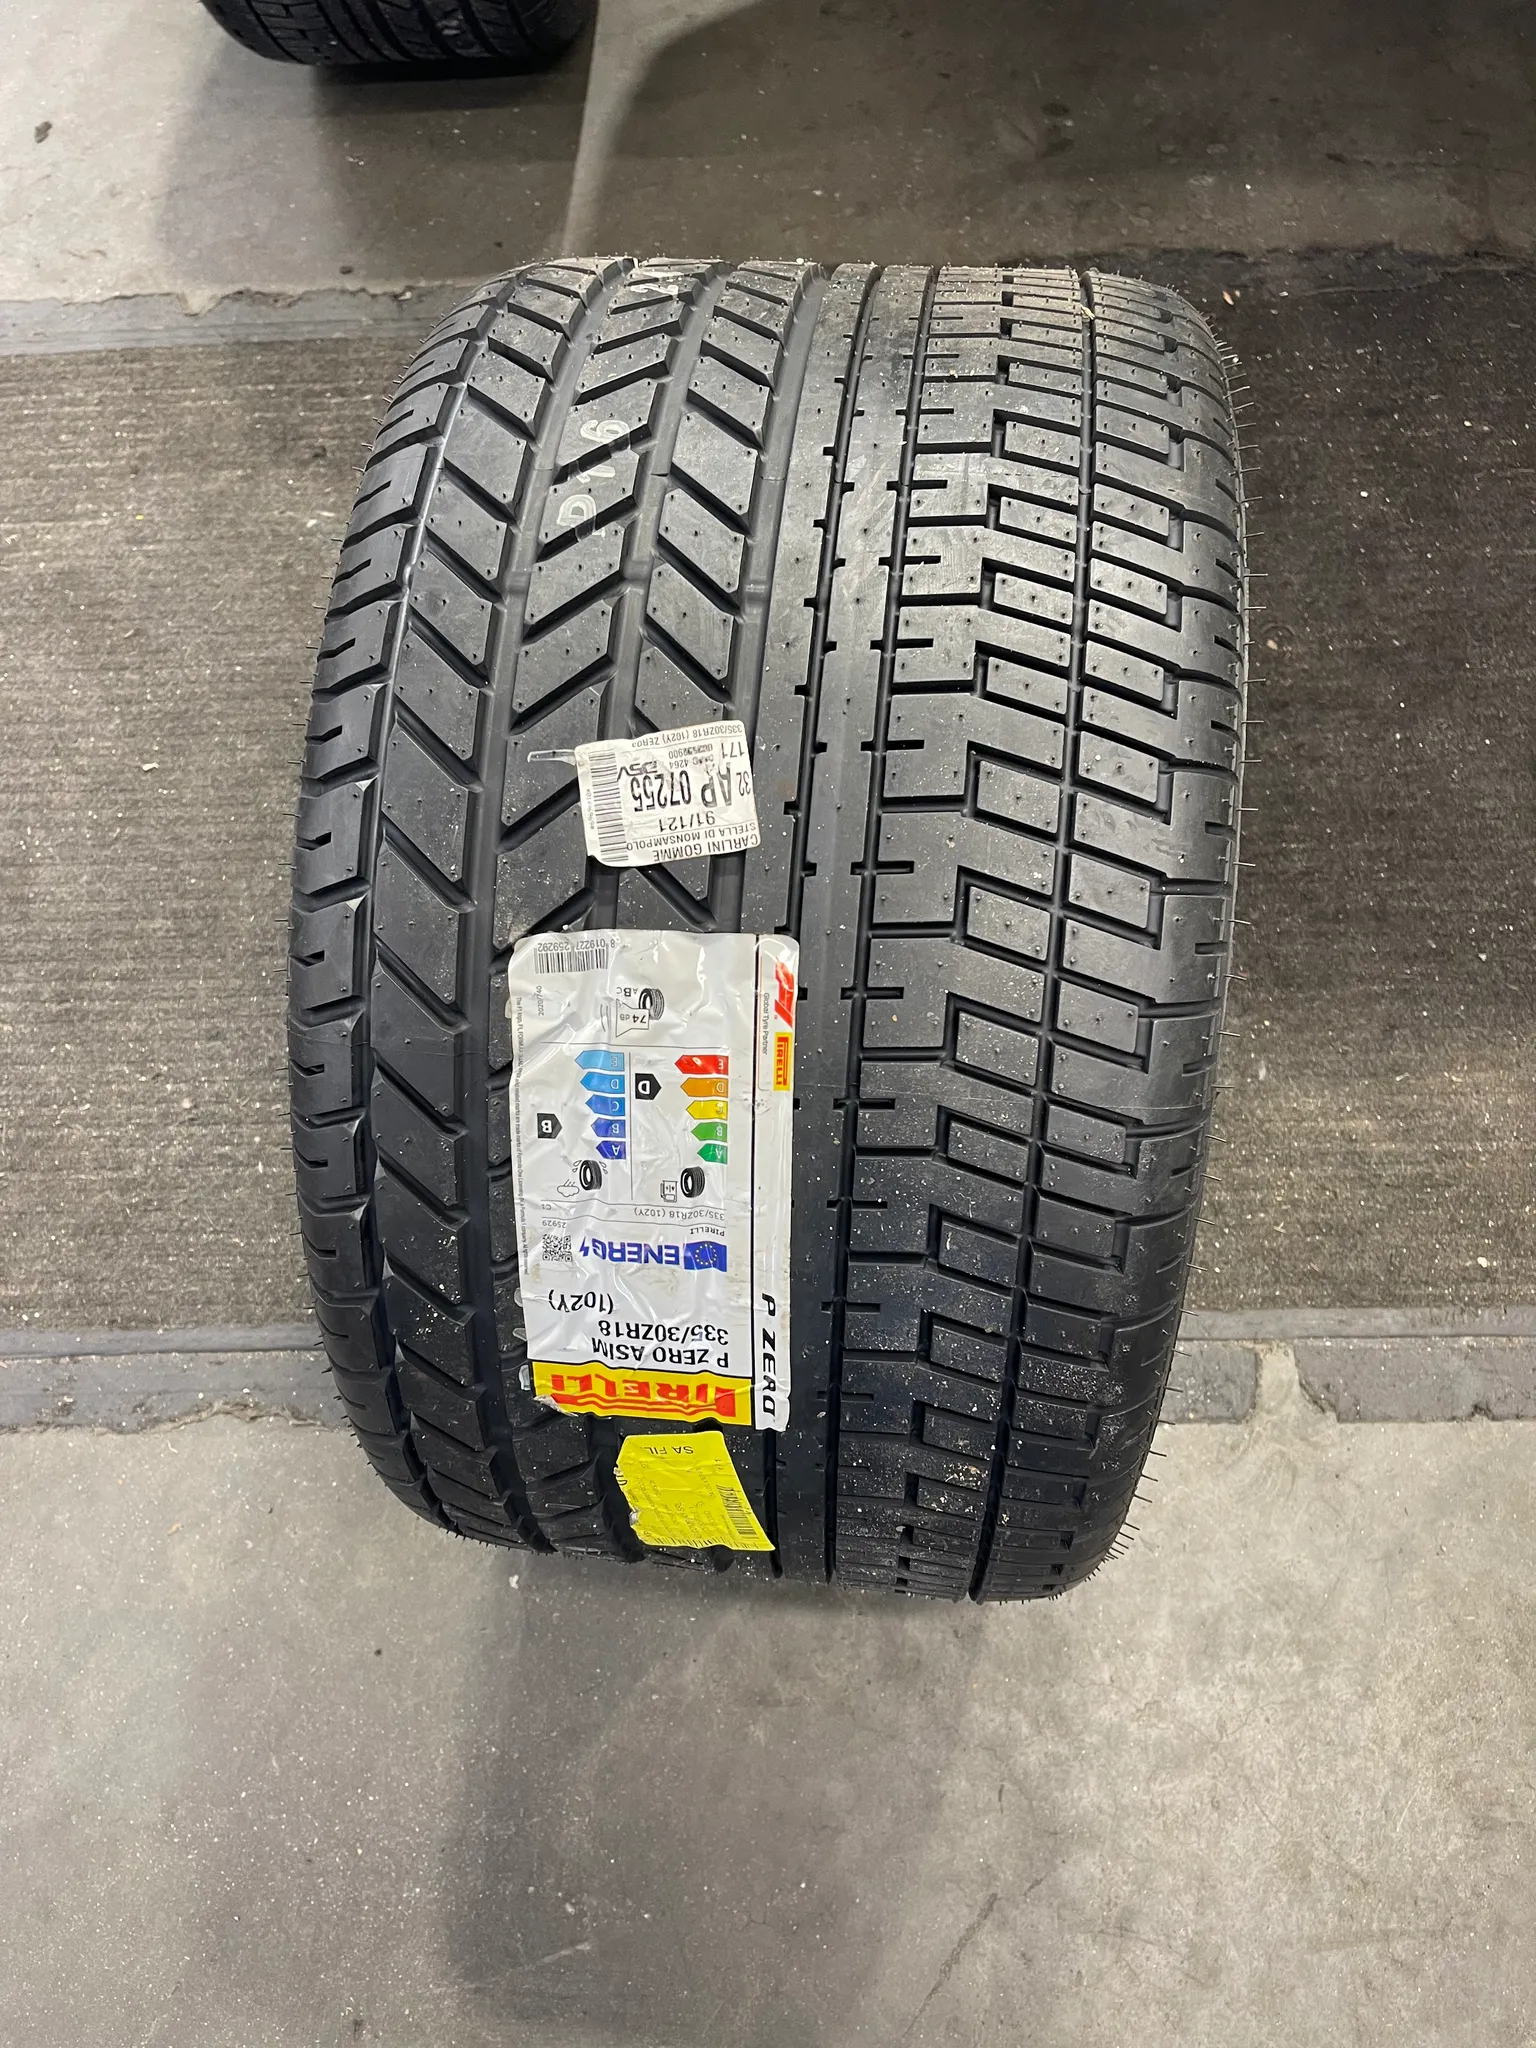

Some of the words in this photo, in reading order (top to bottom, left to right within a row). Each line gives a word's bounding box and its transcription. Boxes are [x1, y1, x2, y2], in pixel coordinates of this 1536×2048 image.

[662, 730, 689, 744] (102Y)
[692, 724, 743, 738] 335/30ZR18
[720, 742, 745, 759] 171
[669, 759, 688, 769] 4264
[701, 762, 732, 808] AP
[736, 771, 750, 796] 32
[629, 770, 691, 812] 07255
[658, 811, 715, 832] 91/121
[704, 830, 715, 839] DI
[719, 822, 756, 837] STELLA
[627, 832, 700, 851] MONSAMPOLO
[707, 834, 758, 853] CARLINI
[652, 843, 702, 862] GOMME
[537, 941, 570, 952] 259292
[576, 938, 605, 950] 019227
[535, 985, 545, 1016] 2020/740
[762, 993, 770, 1015] Global
[620, 1013, 630, 1021] dB
[632, 1014, 647, 1024] 74
[762, 1015, 770, 1030] Tyre
[761, 1031, 769, 1055] Partner
[612, 1055, 619, 1067] E
[717, 1059, 724, 1069] E
[775, 1036, 789, 1086] PIRELLI
[611, 1078, 619, 1089] D
[638, 1080, 651, 1094] D
[717, 1082, 724, 1092] D
[612, 1101, 619, 1111] C
[541, 1120, 552, 1133] B
[612, 1123, 619, 1134] B
[716, 1126, 723, 1136] B
[612, 1144, 620, 1156] A
[715, 1148, 723, 1158] A
[634, 1207, 665, 1218] (102Y)
[669, 1208, 725, 1220] 335/30ZR18
[542, 1220, 566, 1228] 25929
[690, 1228, 724, 1236] PIRELLI
[592, 1239, 680, 1265] ENERG
[548, 1290, 614, 1314] (102Y)
[761, 1293, 776, 1315] P
[598, 1320, 729, 1345] 335/30ZR18
[592, 1338, 645, 1360] ASIM
[653, 1347, 709, 1364] ZERO
[717, 1352, 729, 1367] P
[761, 1328, 776, 1415] ZERO
[551, 1374, 736, 1417] PIRELLI
[672, 1445, 693, 1455] SA
